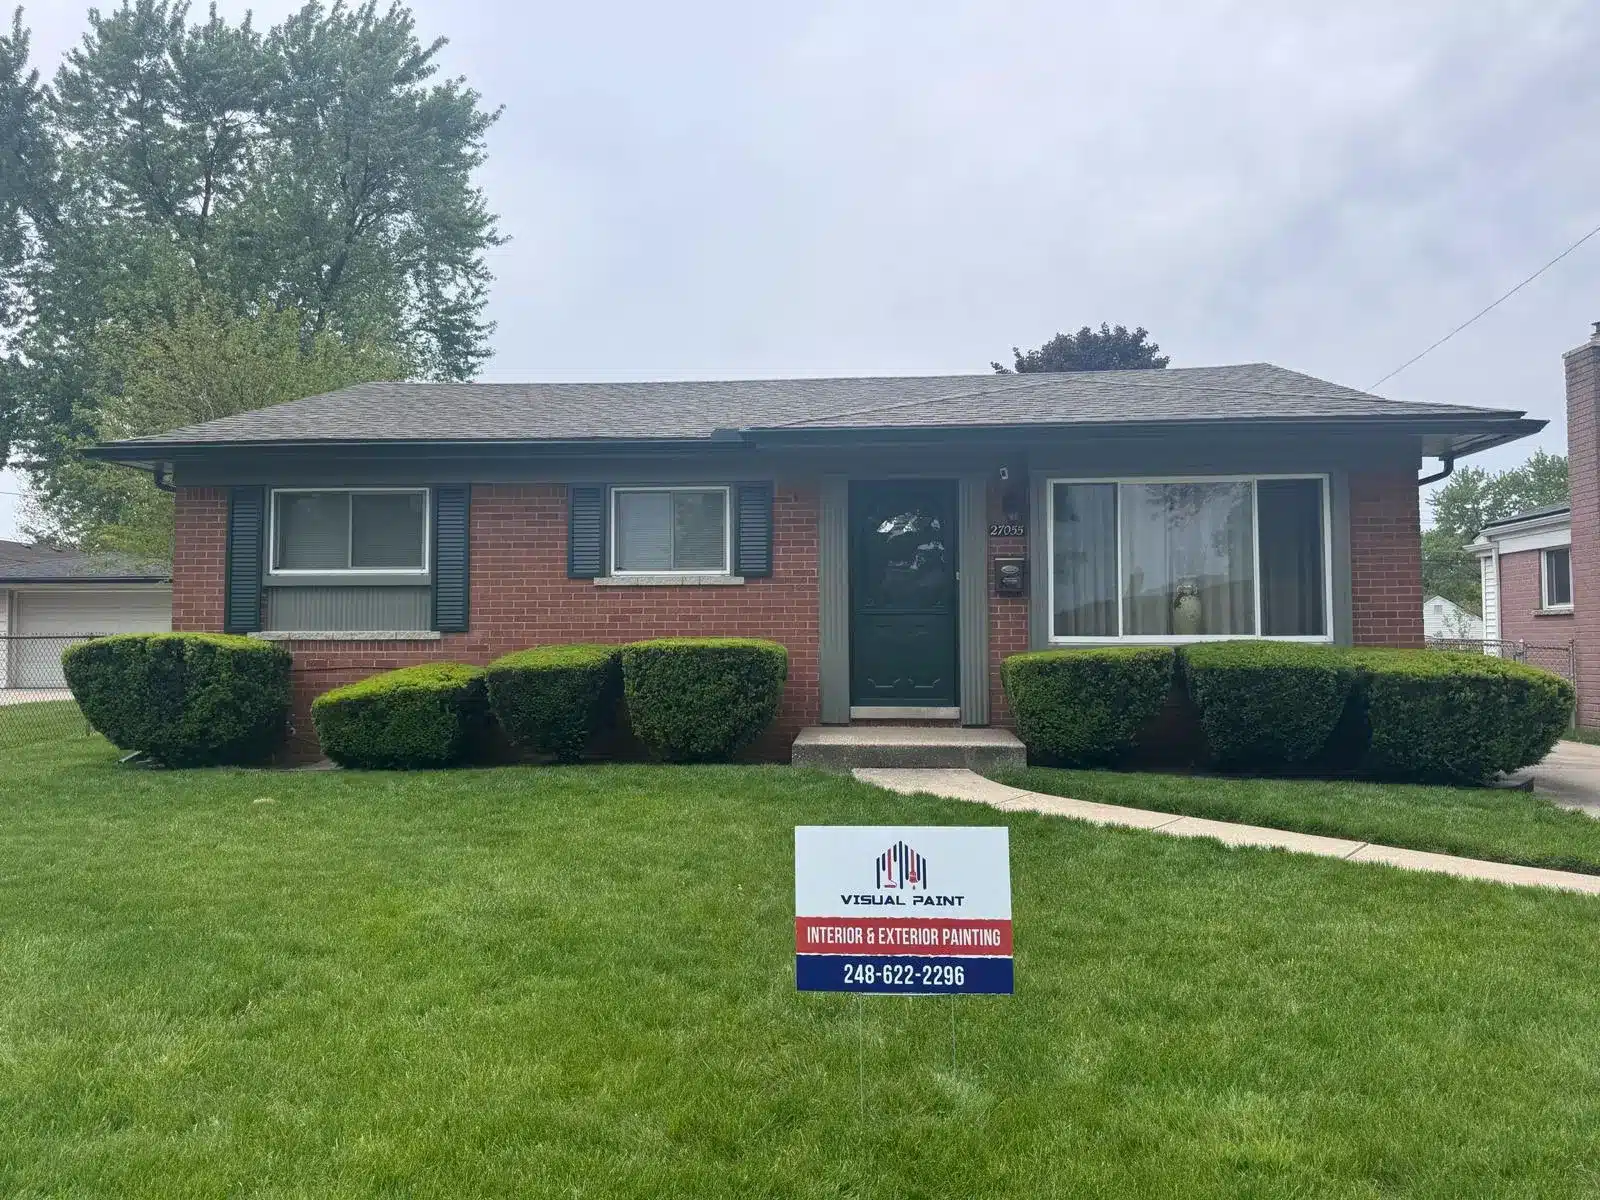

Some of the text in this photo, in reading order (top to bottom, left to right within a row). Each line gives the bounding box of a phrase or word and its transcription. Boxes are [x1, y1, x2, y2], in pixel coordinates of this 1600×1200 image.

[841, 895, 965, 906] VISUAL PAINT
[807, 926, 1001, 947] INTERIOR & EXTERIOR PAINTING
[844, 964, 965, 986] 248-622-2296
